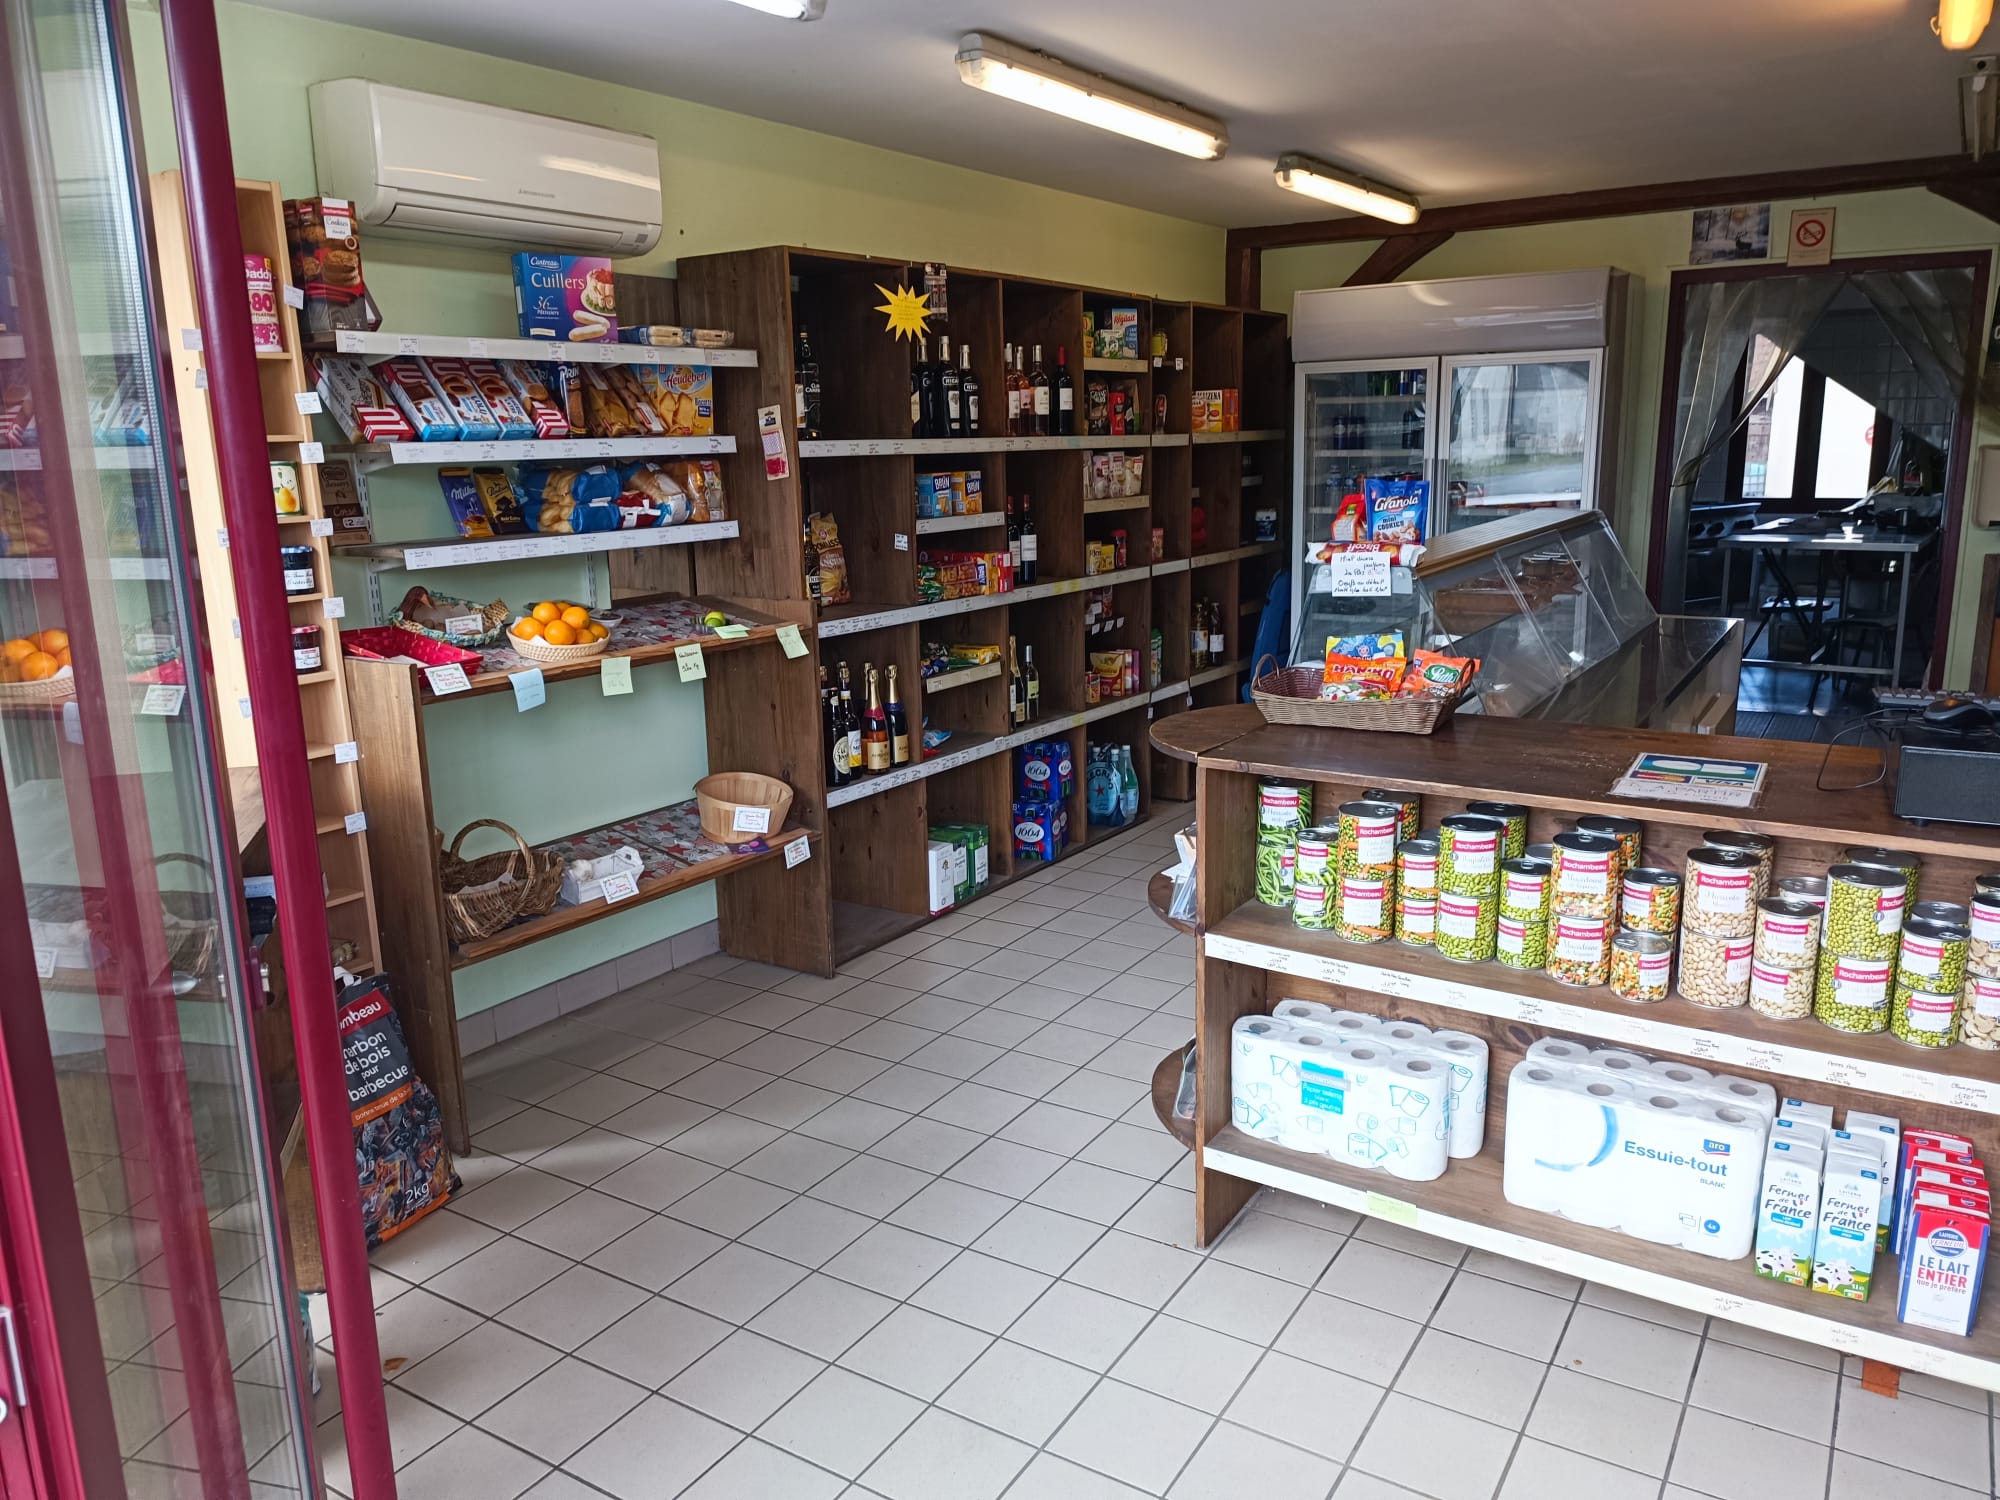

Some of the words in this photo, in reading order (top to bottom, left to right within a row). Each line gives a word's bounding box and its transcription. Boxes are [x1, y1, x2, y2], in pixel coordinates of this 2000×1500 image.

[531, 272, 585, 290] Cuillers
[252, 293, 273, 312] 80
[664, 372, 708, 388] Heudebert
[1375, 495, 1419, 512] Granola
[1377, 520, 1404, 531] COOKIES
[1383, 515, 1397, 523] mini
[1026, 763, 1050, 779] 1664
[1017, 824, 1041, 840] 1664
[1456, 841, 1495, 851] Rochambeau
[1564, 860, 1607, 871] Rochambeau
[1701, 874, 1748, 887] Rochambeau
[1561, 928, 1603, 939] Rochambeau
[1839, 969, 1887, 981] Rochambeau
[1911, 1000, 1953, 1012] Rochambeau
[345, 1060, 360, 1075] de
[357, 1045, 391, 1069] bois
[361, 1065, 379, 1081] pour
[348, 1064, 409, 1102] barbecue
[1709, 1142, 1725, 1152] aro
[1625, 1139, 1729, 1177] Essuie-tout
[1700, 1177, 1726, 1190] BLANC
[405, 1181, 430, 1203] 2kg
[1769, 1184, 1810, 1202] Fermes
[1765, 1199, 1812, 1219] France
[1827, 1197, 1870, 1215] Fermes
[1823, 1211, 1872, 1232] France
[1919, 1254, 1936, 1270] LE
[1938, 1258, 1971, 1277] LAIT
[1916, 1279, 1931, 1288] que
[1930, 1280, 1938, 1290] je
[1917, 1266, 1968, 1290] ENTIER
